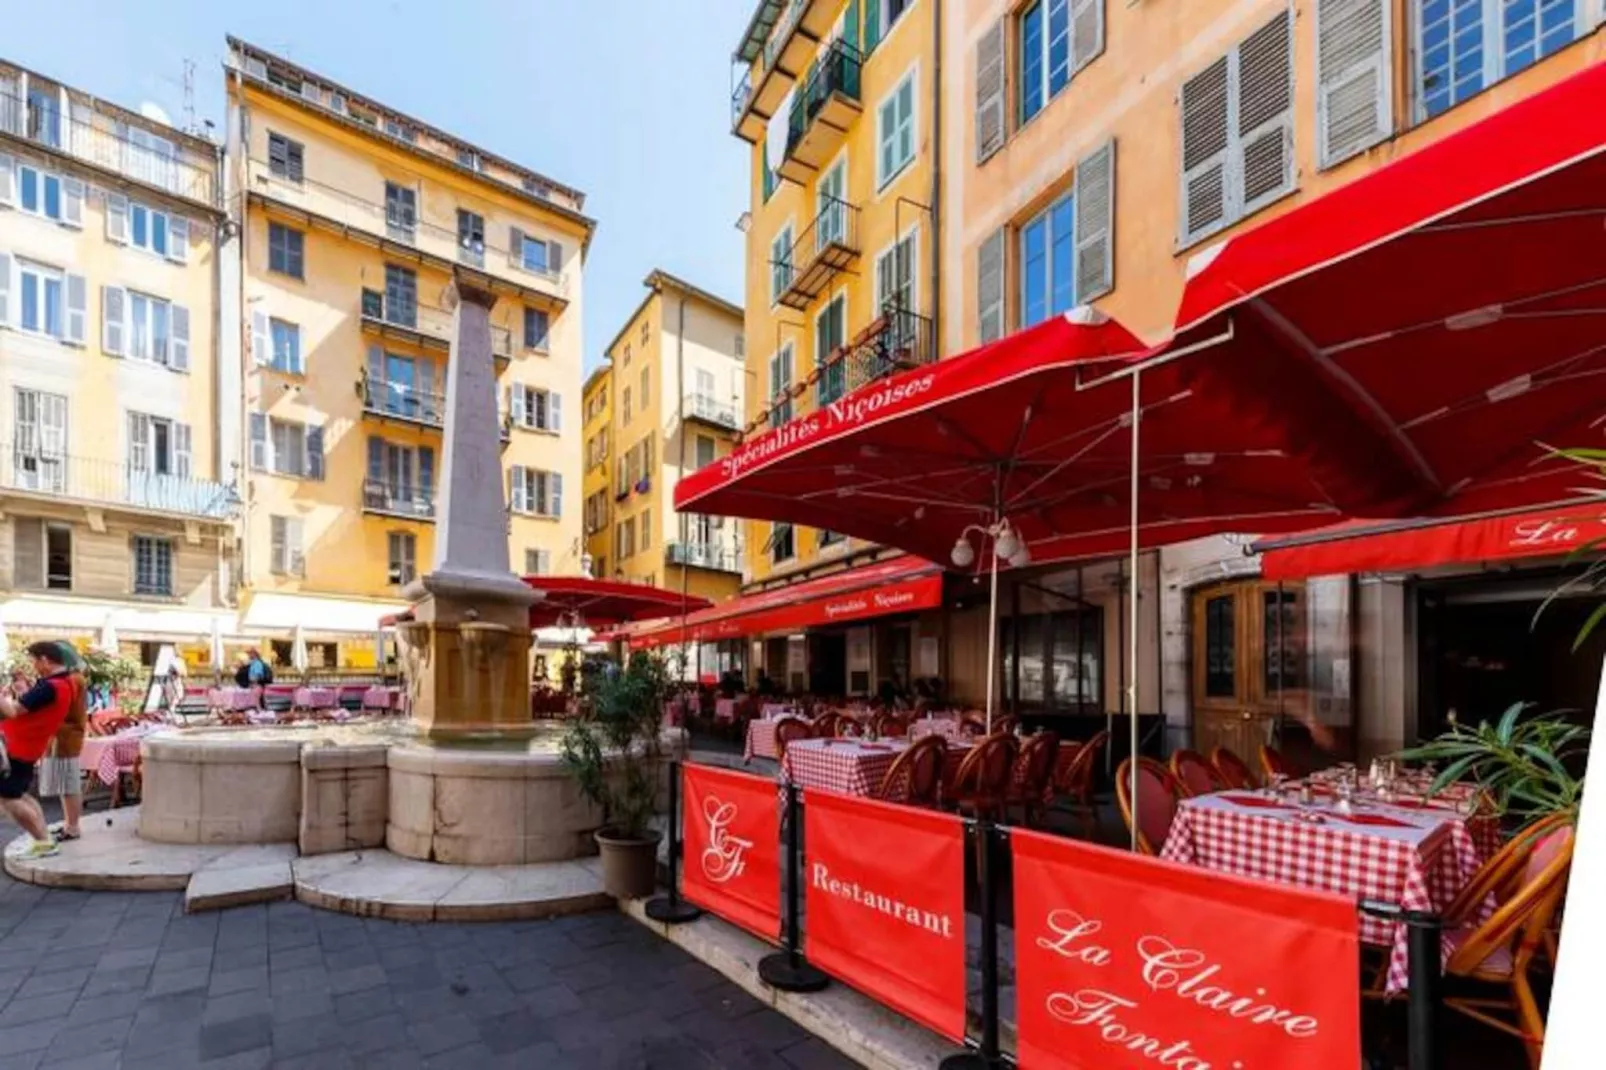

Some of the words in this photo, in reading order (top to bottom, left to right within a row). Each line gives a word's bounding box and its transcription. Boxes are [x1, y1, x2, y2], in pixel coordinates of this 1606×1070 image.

[720, 417, 820, 477] Spécialités
[824, 373, 935, 429] Niçoises
[1508, 516, 1578, 547] La
[812, 863, 954, 938] Restaurant
[1036, 908, 1111, 967] La
[1137, 935, 1318, 1037] Claire
[1046, 989, 1243, 1070] Fonta
